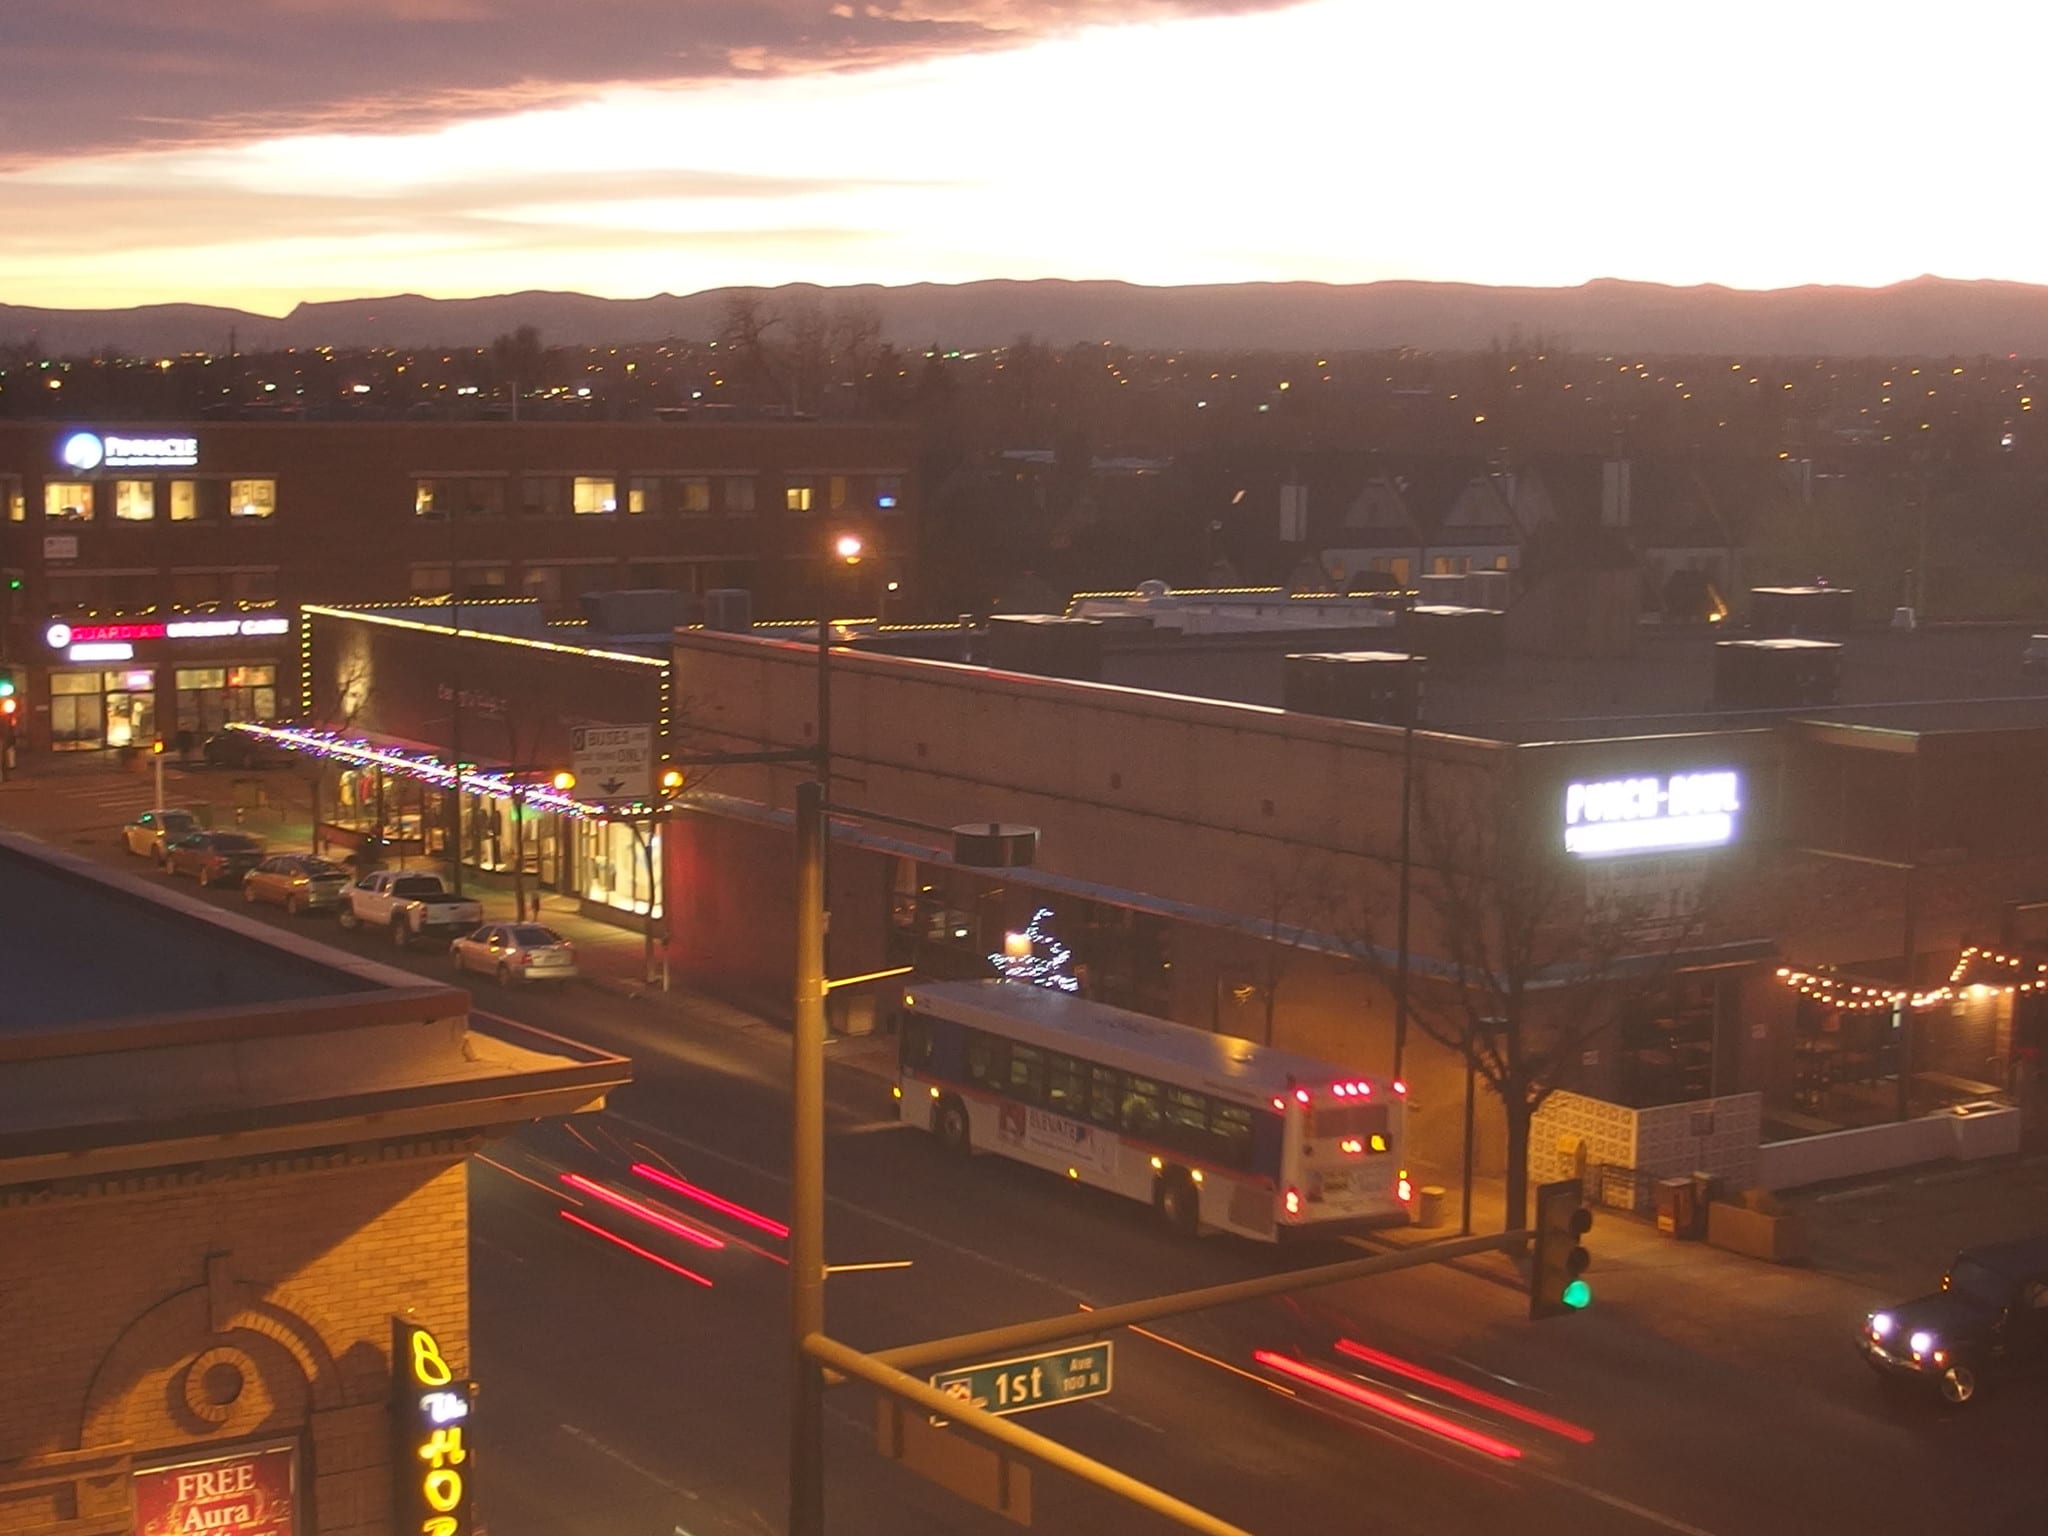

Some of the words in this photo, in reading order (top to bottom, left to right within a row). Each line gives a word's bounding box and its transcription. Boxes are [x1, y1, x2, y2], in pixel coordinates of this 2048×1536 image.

[70, 623, 165, 641] GUARDIAN
[587, 731, 630, 746] BUSES
[995, 1366, 1043, 1405] 1st
[1069, 1357, 1094, 1372] Ave
[1062, 1374, 1086, 1392] 100
[1089, 1371, 1100, 1386] N
[176, 1464, 256, 1503] FREE
[183, 1503, 250, 1534] Aura
